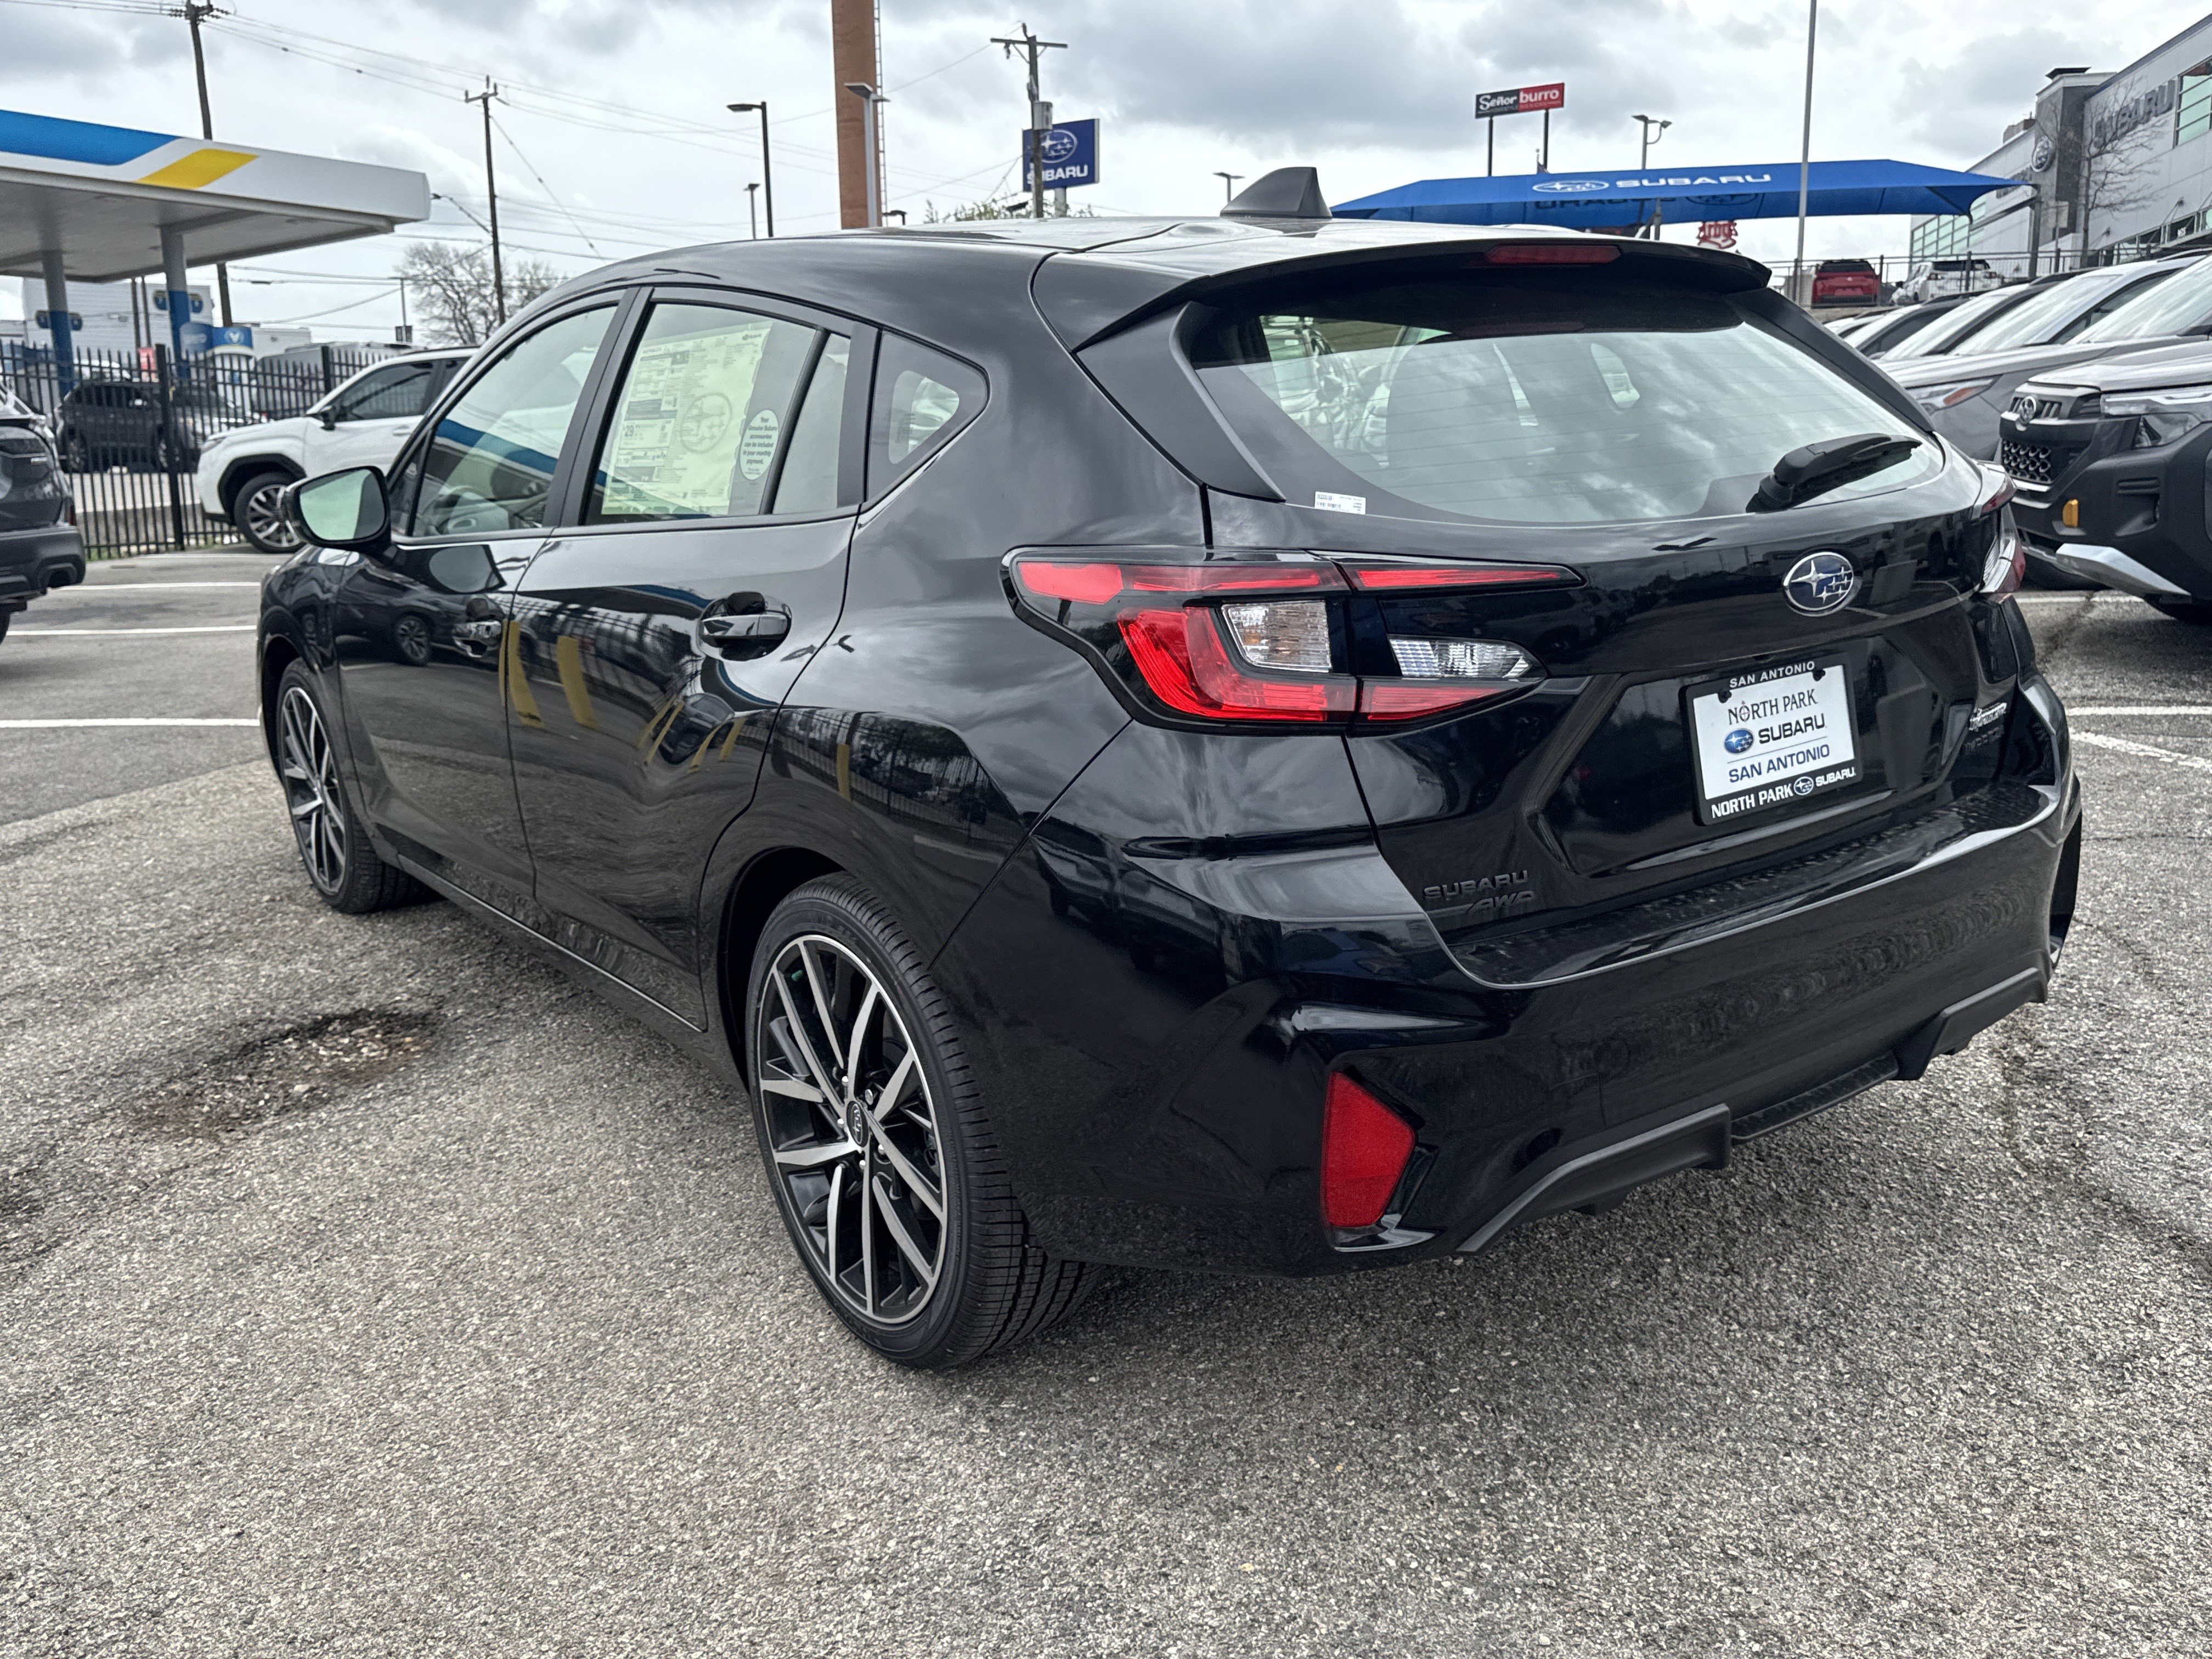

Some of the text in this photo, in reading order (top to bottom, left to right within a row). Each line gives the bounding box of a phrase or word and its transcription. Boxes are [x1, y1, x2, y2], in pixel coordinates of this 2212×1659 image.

[1479, 95, 1517, 110] Señor
[1519, 89, 1560, 103] burro
[1616, 174, 1771, 188] SUBARU
[1729, 661, 1815, 688] SAN ANTONIO
[1728, 689, 1818, 725] NORTH PARK
[1758, 713, 1825, 744] SUBARU
[1729, 744, 1830, 783] SAN ANTONIO
[1711, 766, 1855, 819] NORTH PARK SUBARU
[1423, 870, 1528, 900] SUBARU
[1466, 890, 1537, 913] AWD
